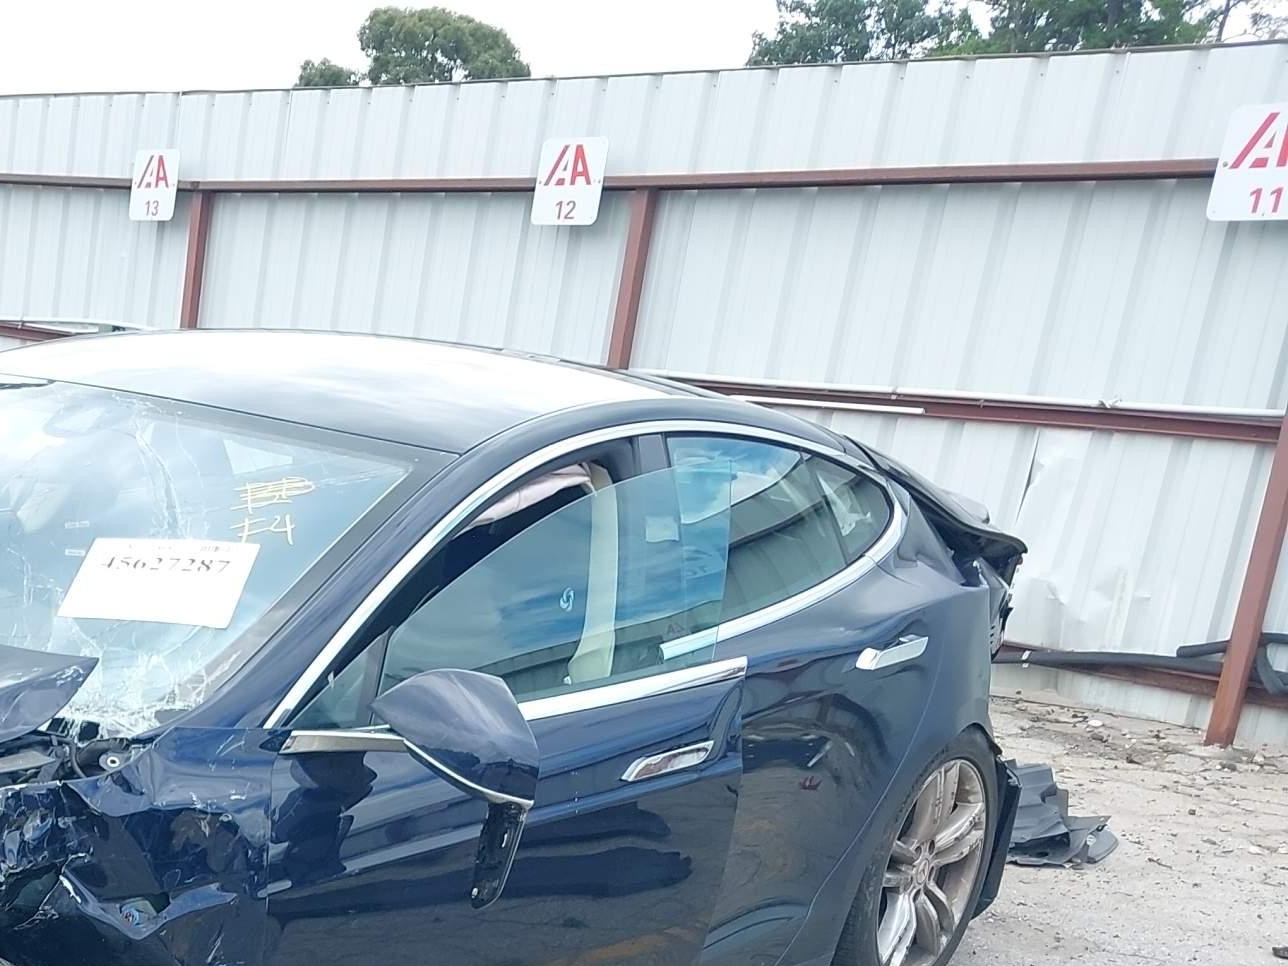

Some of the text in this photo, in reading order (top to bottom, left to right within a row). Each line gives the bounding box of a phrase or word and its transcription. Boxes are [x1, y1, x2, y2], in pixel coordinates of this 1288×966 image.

[145, 200, 160, 217] 13
[554, 200, 577, 220] 12
[1249, 187, 1284, 214] 11
[101, 556, 231, 574] 45627287
